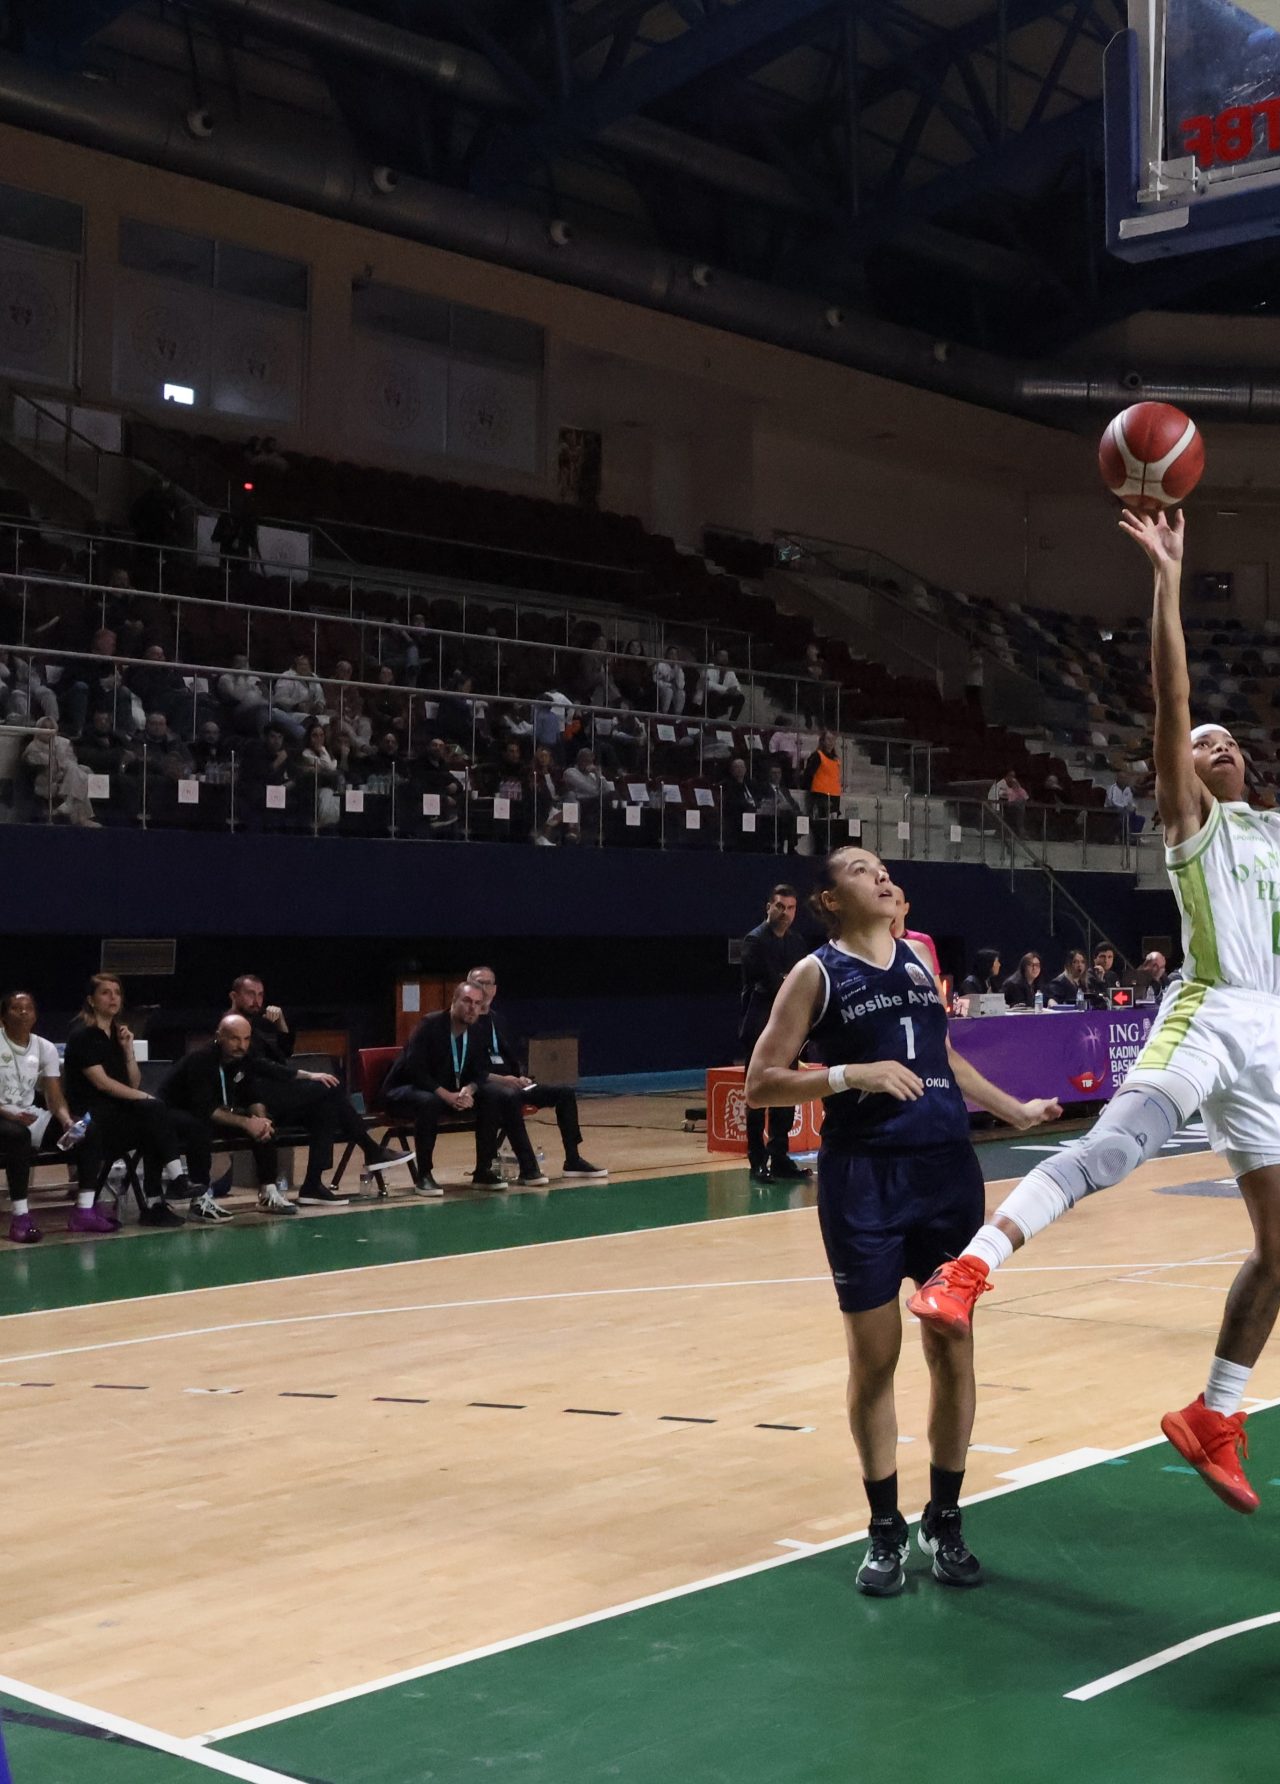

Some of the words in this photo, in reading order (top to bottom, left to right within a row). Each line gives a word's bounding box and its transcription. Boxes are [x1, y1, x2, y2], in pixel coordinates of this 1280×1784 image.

[840, 994, 903, 1024] Nesibe
[899, 1016, 915, 1060] 1
[1109, 1023, 1139, 1043] ING
[1082, 1079, 1093, 1088] TBF
